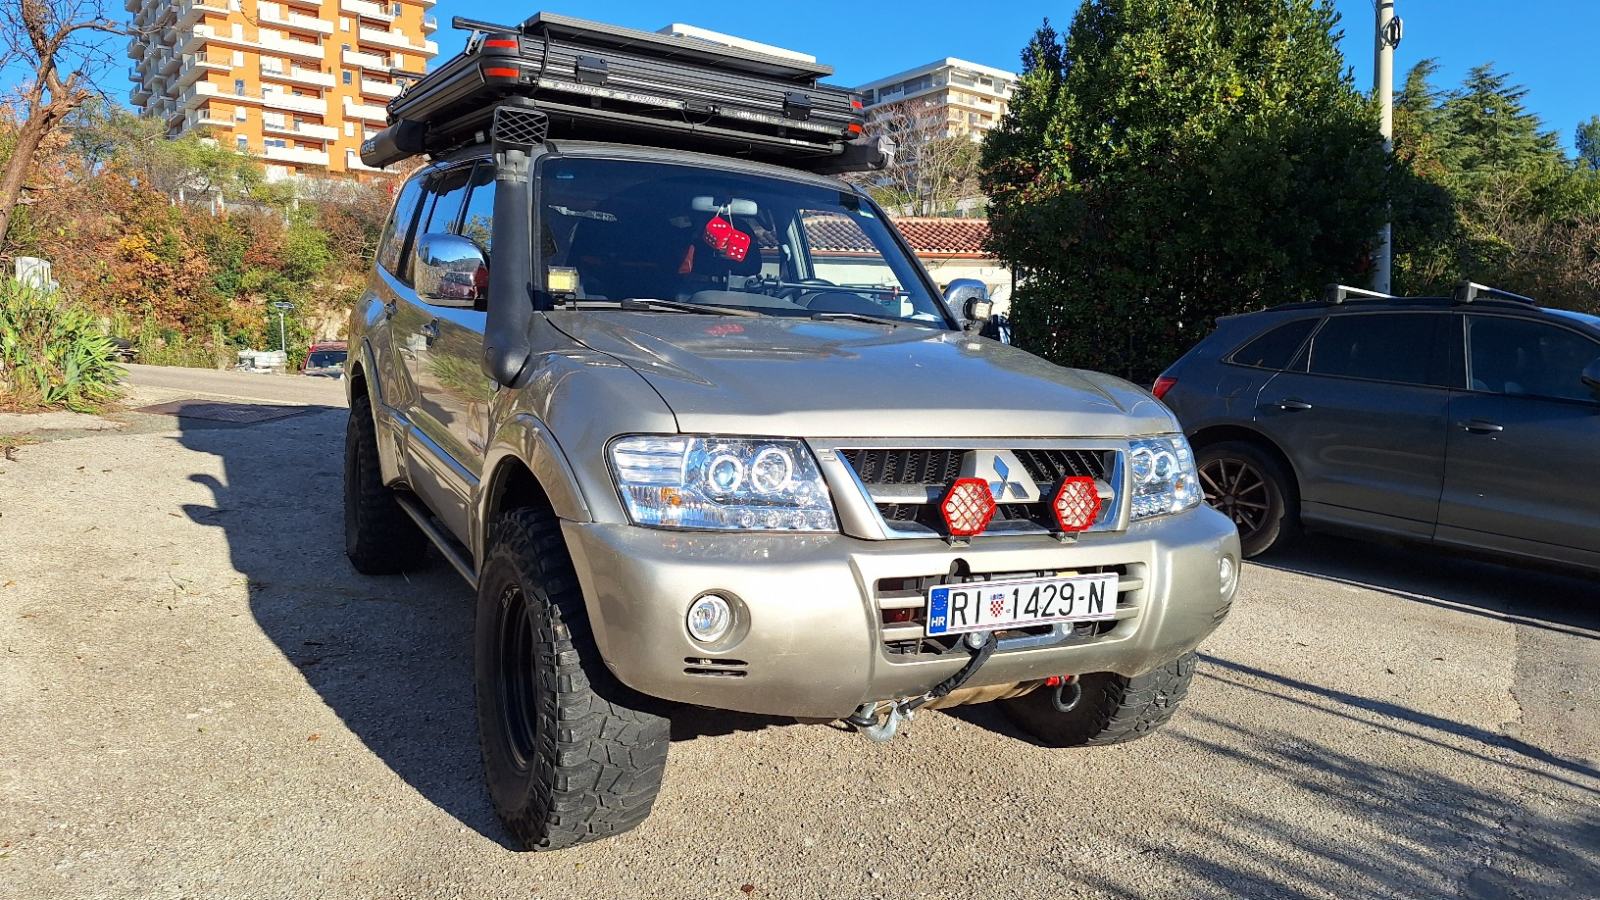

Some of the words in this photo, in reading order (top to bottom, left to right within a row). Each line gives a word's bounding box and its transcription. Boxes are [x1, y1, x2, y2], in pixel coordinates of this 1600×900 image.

[951, 591, 981, 626] RI
[1012, 581, 1105, 619] 1429-N
[931, 616, 946, 627] HR
